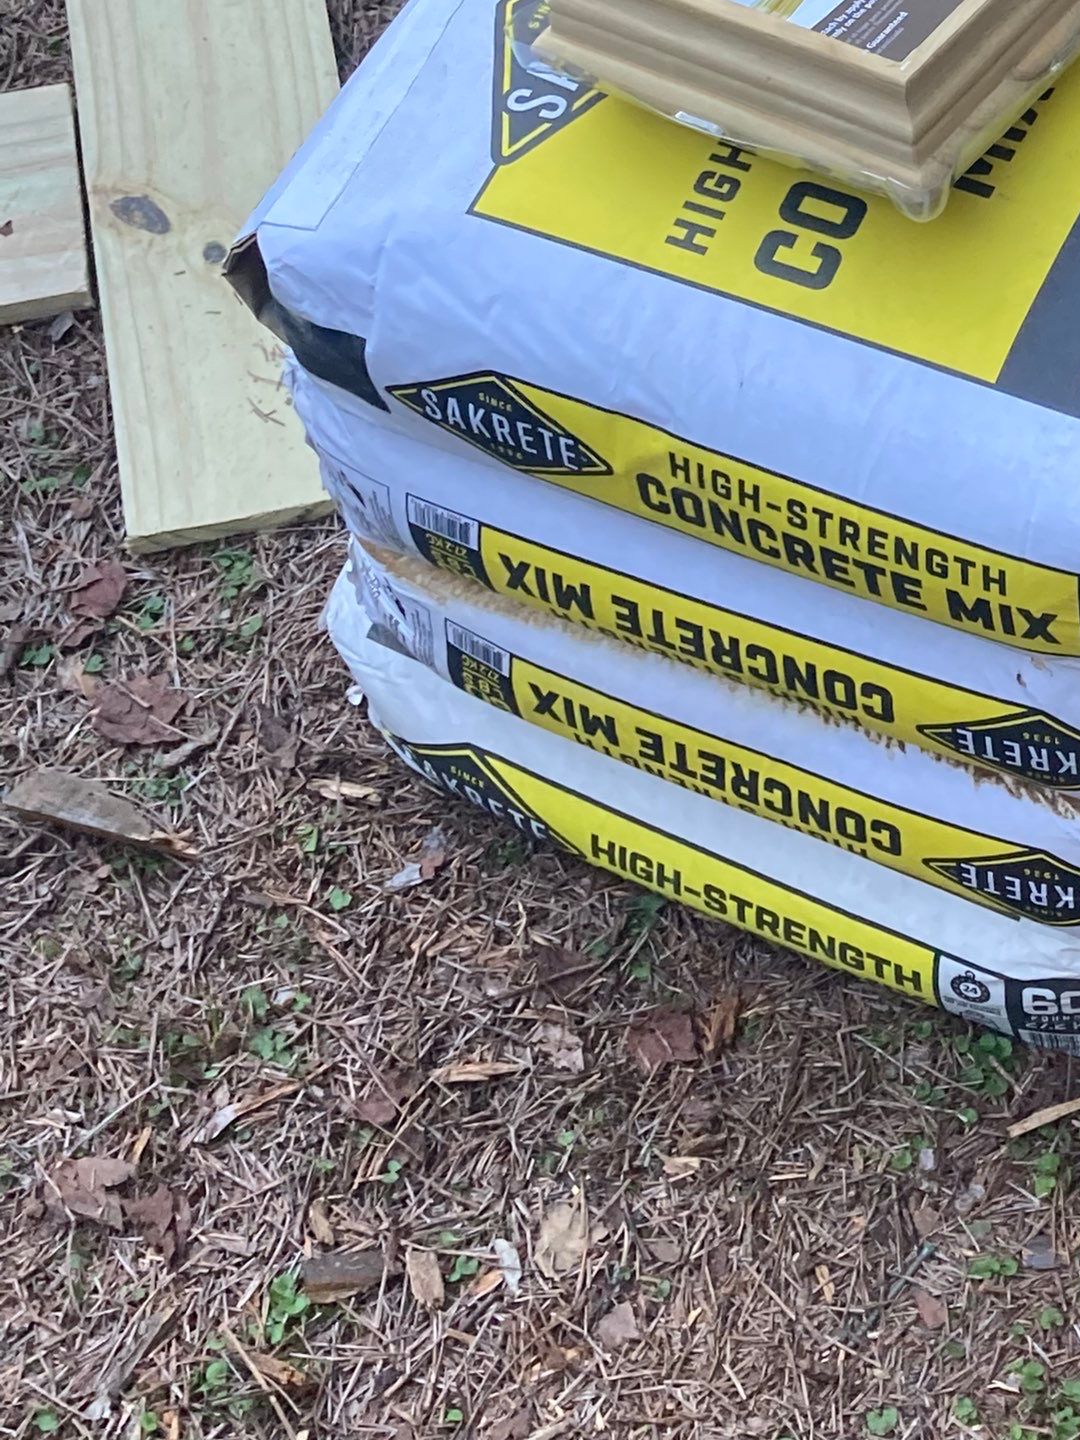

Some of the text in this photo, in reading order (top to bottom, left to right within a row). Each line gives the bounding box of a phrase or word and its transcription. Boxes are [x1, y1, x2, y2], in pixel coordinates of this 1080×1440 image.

[851, 8, 867, 19] the
[866, 11, 908, 49] Guaranteed
[421, 388, 580, 471] SAKRETE
[478, 391, 514, 413] SINCE
[635, 472, 1062, 644] CONCRETE MIX
[668, 451, 1008, 597] HIGH-STRENGTH
[497, 552, 596, 621] MIX
[610, 594, 895, 724] CONCRETE
[528, 682, 620, 748] MIX
[635, 726, 902, 856] CONCRETE
[590, 833, 923, 994] HIGH-STRENGTH
[962, 983, 979, 996] 24
